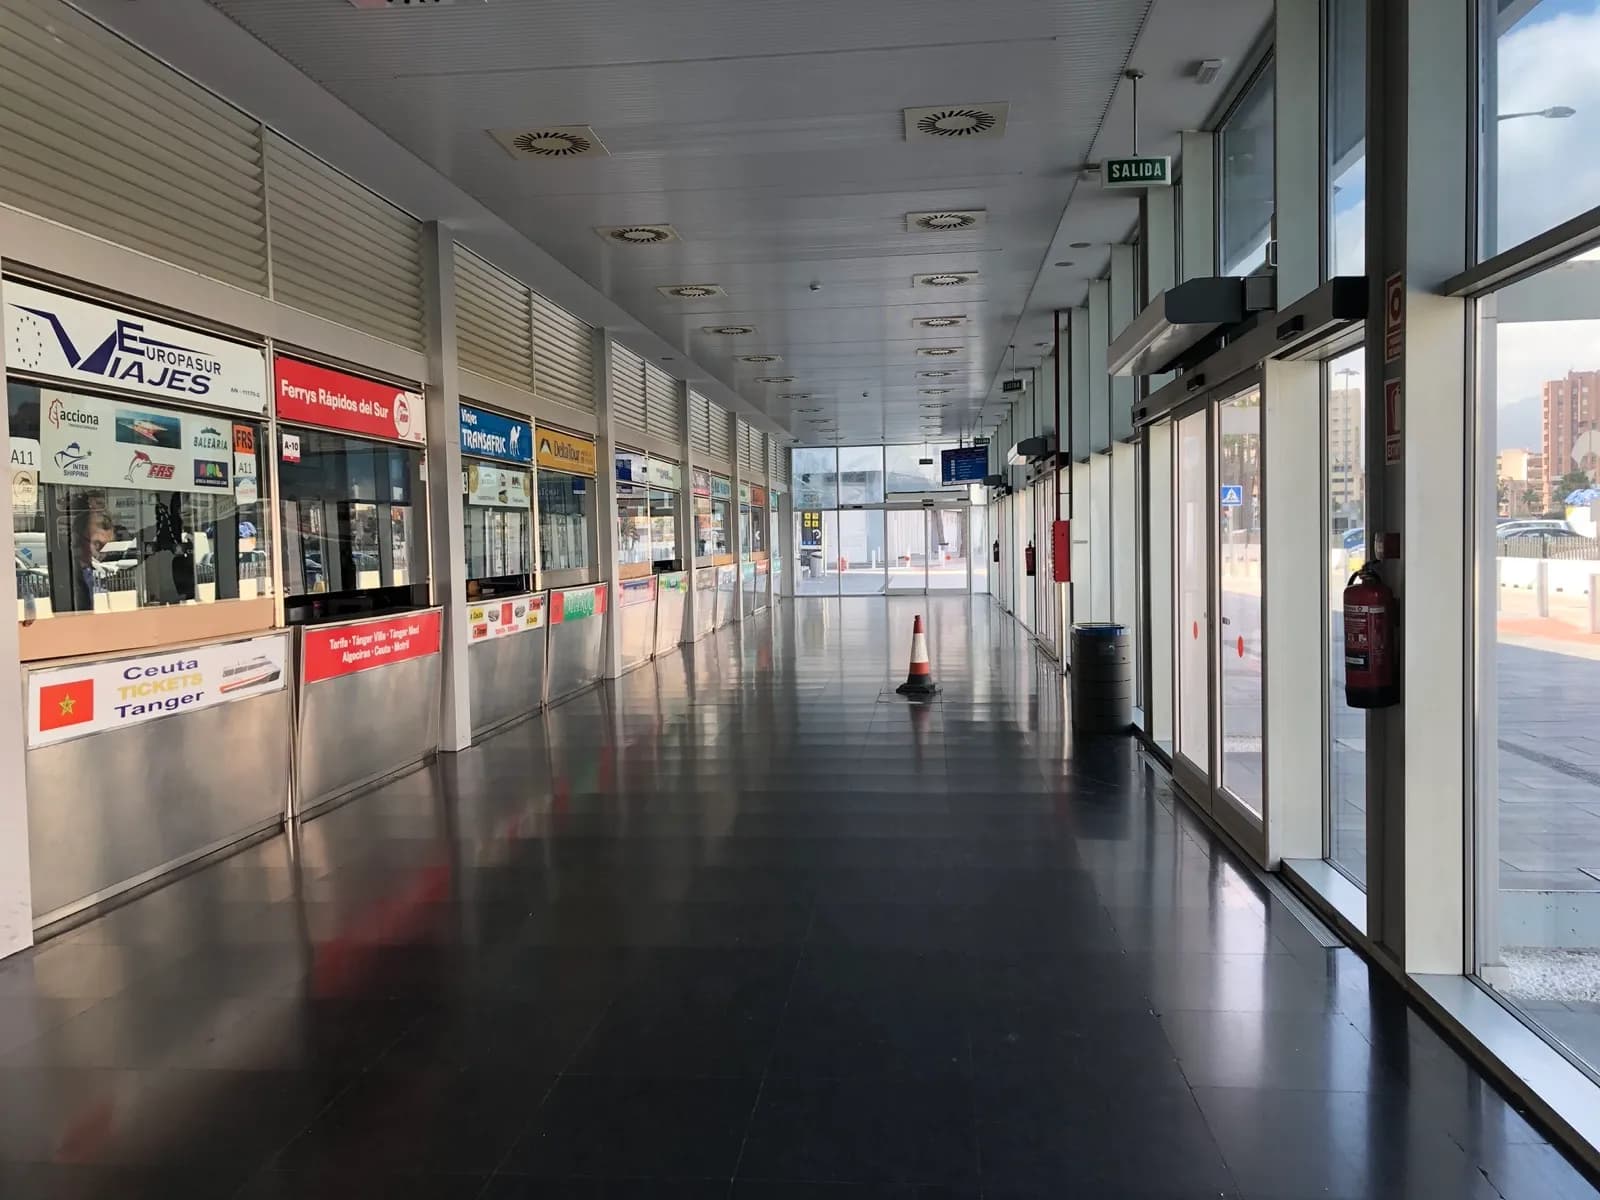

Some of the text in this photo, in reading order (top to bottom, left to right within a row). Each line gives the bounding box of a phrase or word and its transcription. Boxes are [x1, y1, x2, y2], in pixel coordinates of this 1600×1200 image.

[1112, 162, 1162, 178] SALIDA
[281, 379, 389, 419] Ferrys Rápidos del Sur
[60, 409, 99, 426] acciona
[461, 408, 477, 426] Viajes
[235, 429, 253, 451] FRS
[284, 440, 299, 451] A-10
[10, 448, 34, 466] A11
[63, 469, 89, 478] SHIPPING
[72, 463, 89, 471] INTER
[149, 463, 175, 478] FRS
[329, 636, 348, 650] Tarifa
[374, 645, 391, 657] Ceuta
[394, 639, 410, 652] Motril
[123, 659, 199, 681] Ceuta
[117, 672, 203, 701] TICKETS
[114, 691, 205, 718] Tanger
